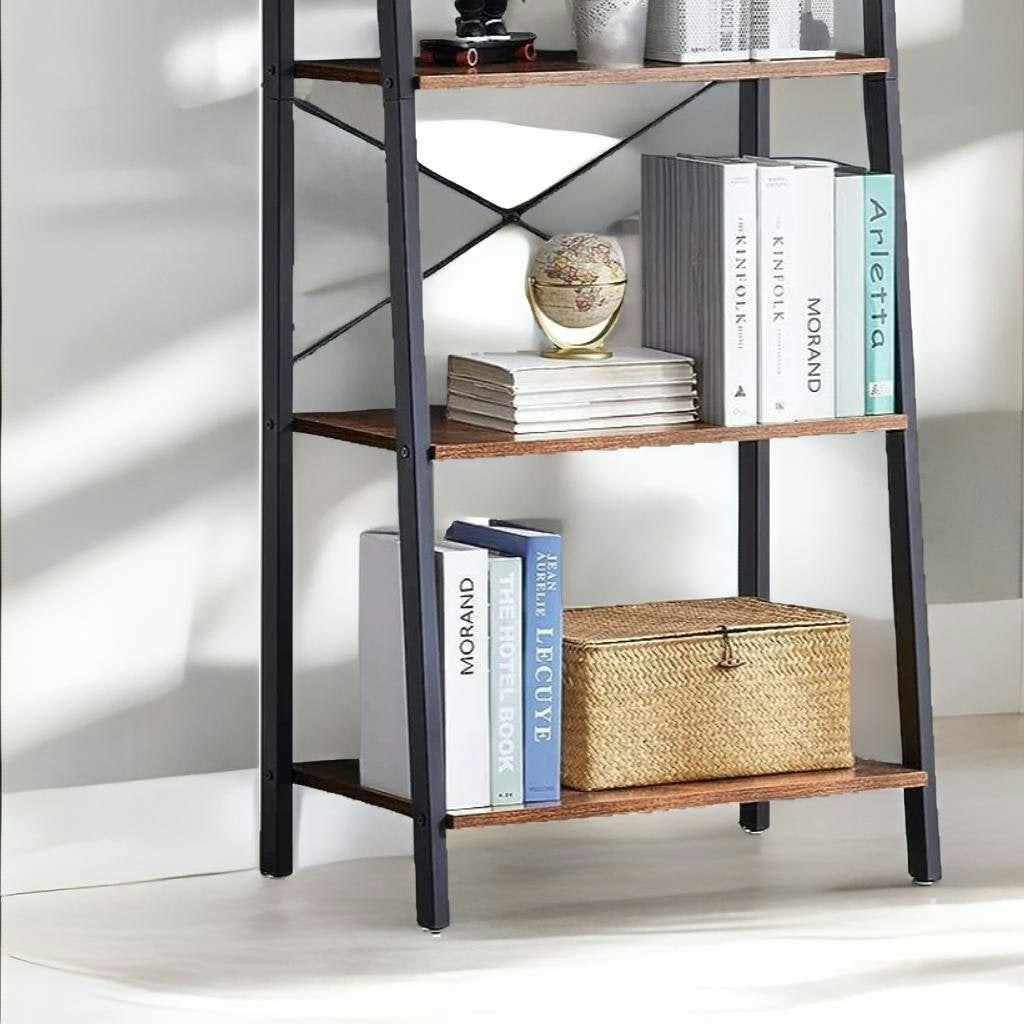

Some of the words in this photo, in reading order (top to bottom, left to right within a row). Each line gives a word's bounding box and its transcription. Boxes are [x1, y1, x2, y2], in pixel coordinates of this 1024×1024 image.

[735, 235, 748, 324] KINFOLK
[772, 236, 785, 323] KINFOLK
[869, 197, 889, 349] Arletta
[807, 297, 822, 393] MORAND
[499, 572, 515, 620] THE
[535, 551, 547, 617] AURELIE
[546, 552, 558, 592] JEAN
[459, 577, 475, 676] MORAND
[498, 627, 515, 701] HOTEL
[534, 627, 554, 743] LECUYE
[497, 707, 514, 774] BOOK
